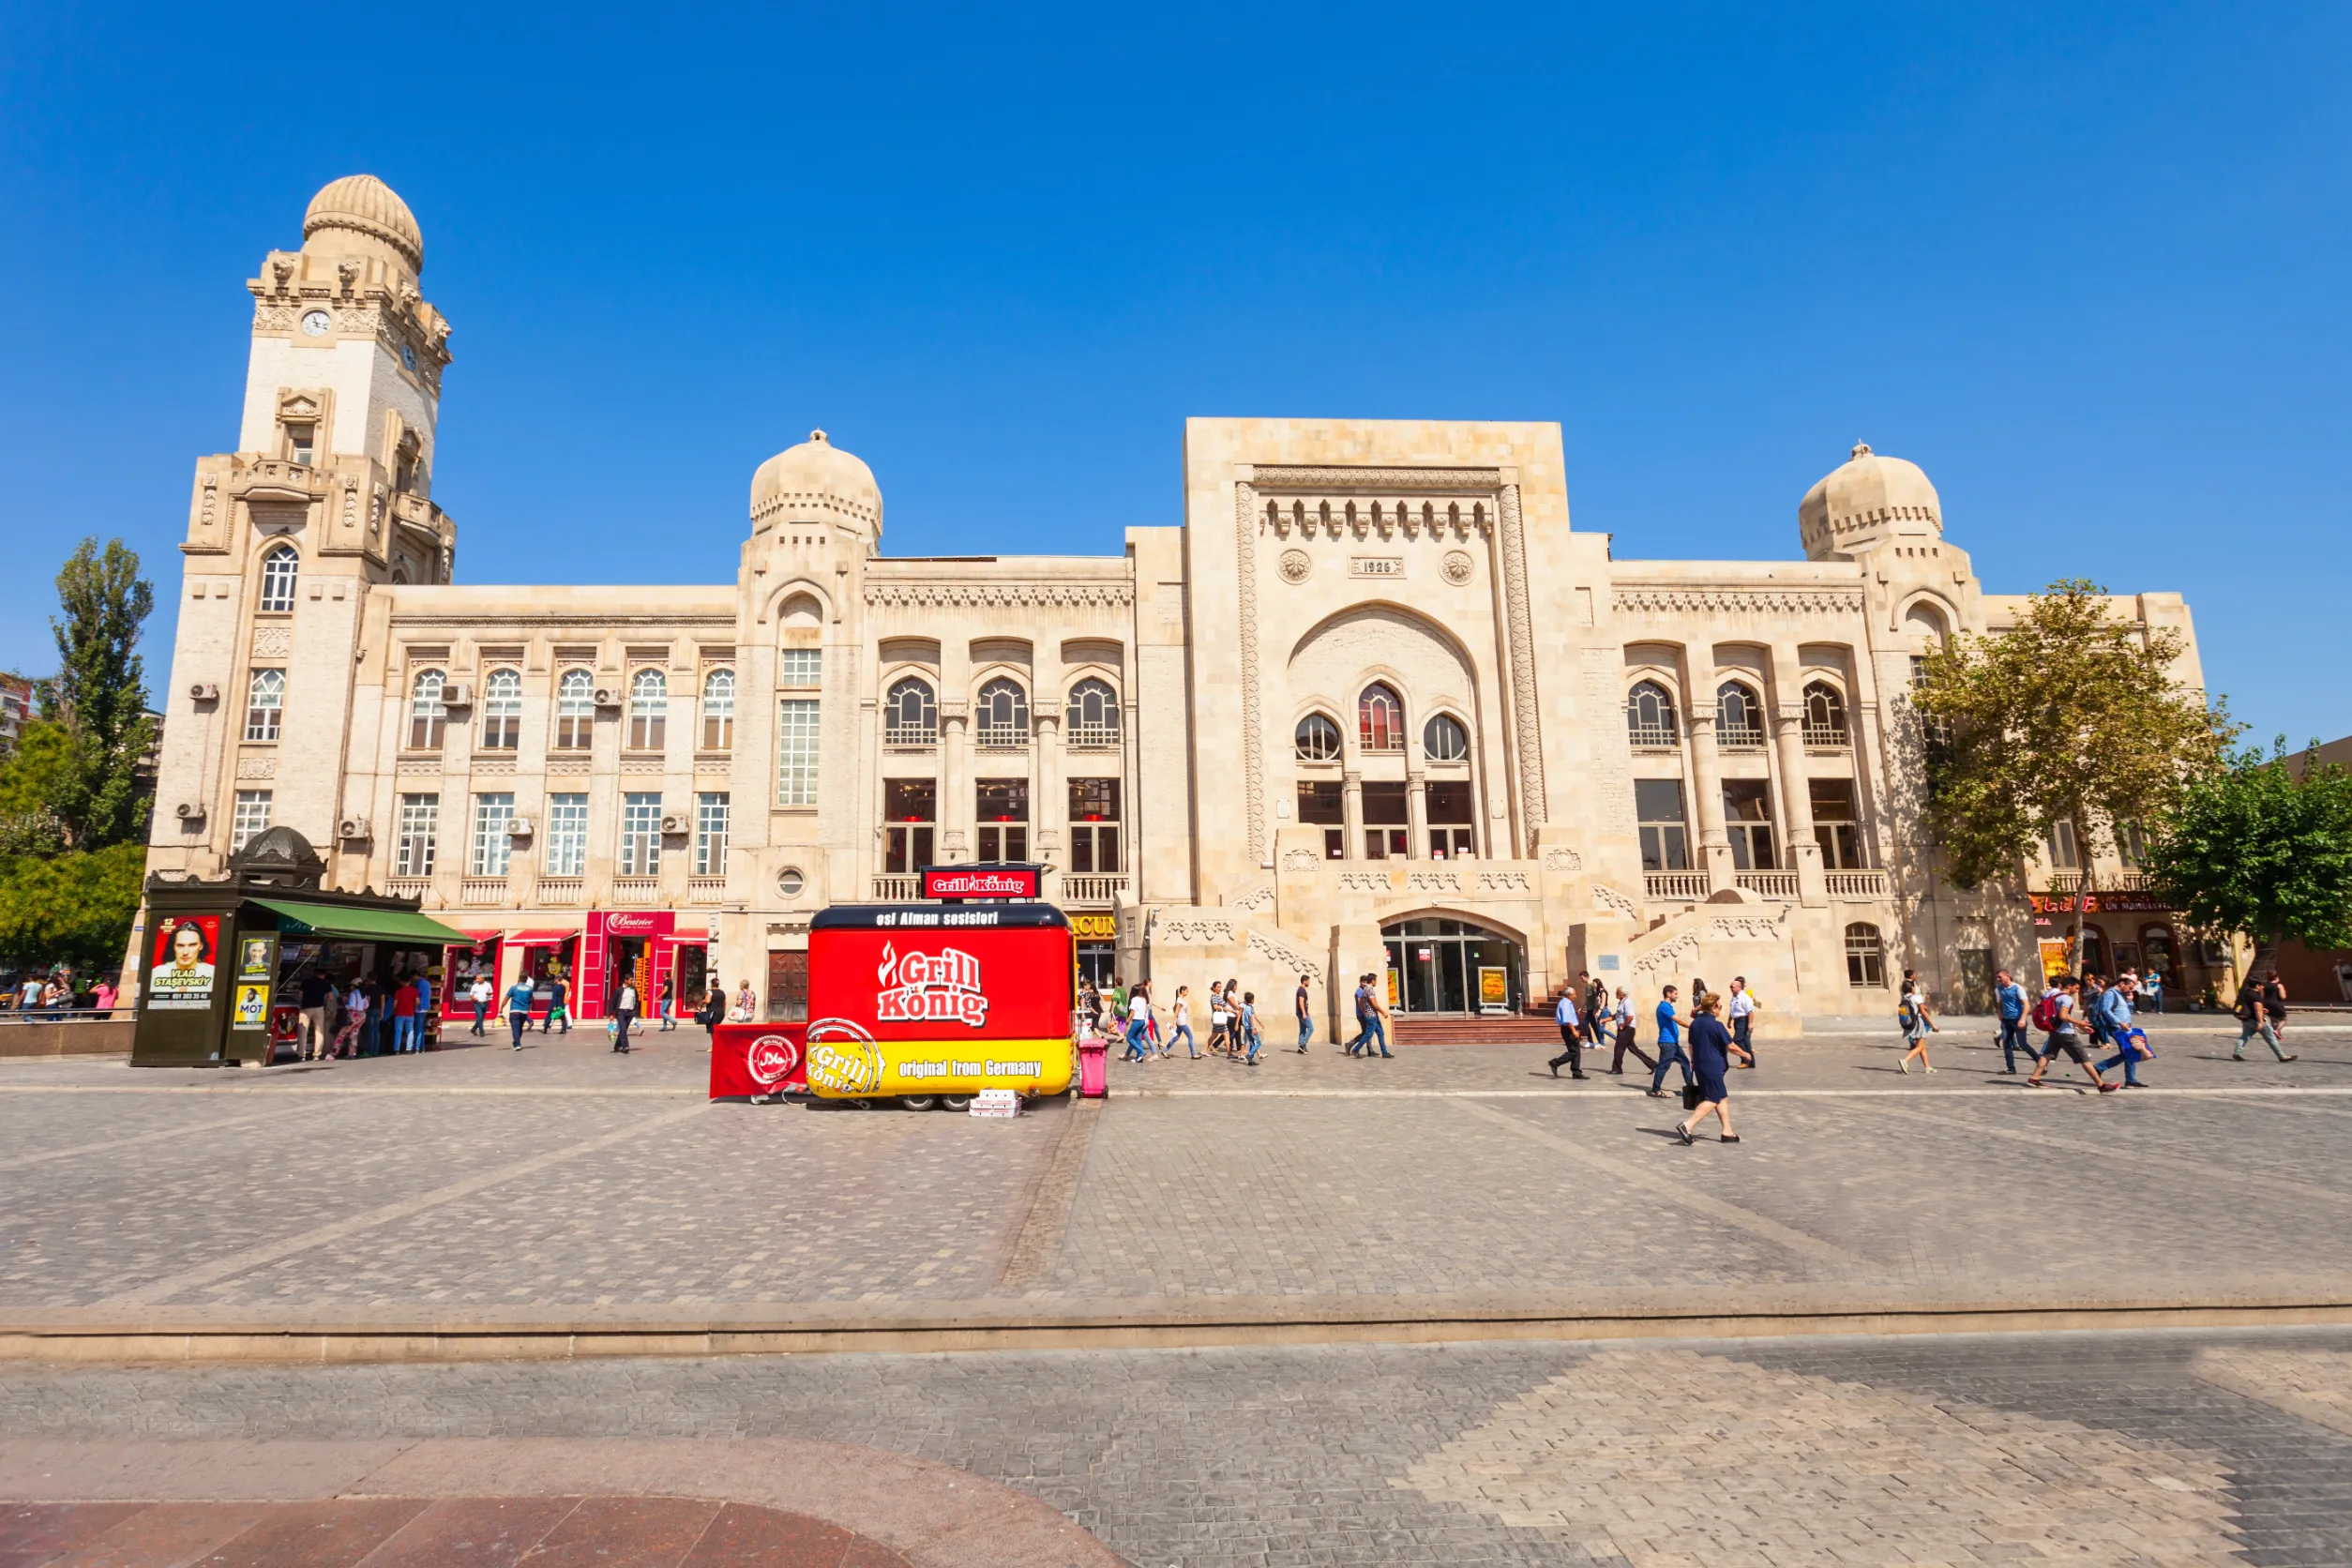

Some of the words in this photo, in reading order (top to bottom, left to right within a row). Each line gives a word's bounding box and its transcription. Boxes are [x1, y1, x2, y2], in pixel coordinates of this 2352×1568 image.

[1364, 562, 1391, 573] 1926
[933, 878, 970, 892] Grill
[975, 876, 1025, 894] König
[899, 912, 939, 926] Alman
[171, 969, 197, 978] VLAD
[898, 947, 981, 993] Grill
[154, 975, 212, 988] STAŞEVSKİY
[239, 1004, 263, 1014] MOT
[878, 985, 989, 1028] König
[760, 1051, 786, 1066] حلال
[816, 1046, 867, 1085] Grill
[898, 1060, 948, 1079] original
[951, 1060, 982, 1077] from
[985, 1059, 1043, 1078] Germany
